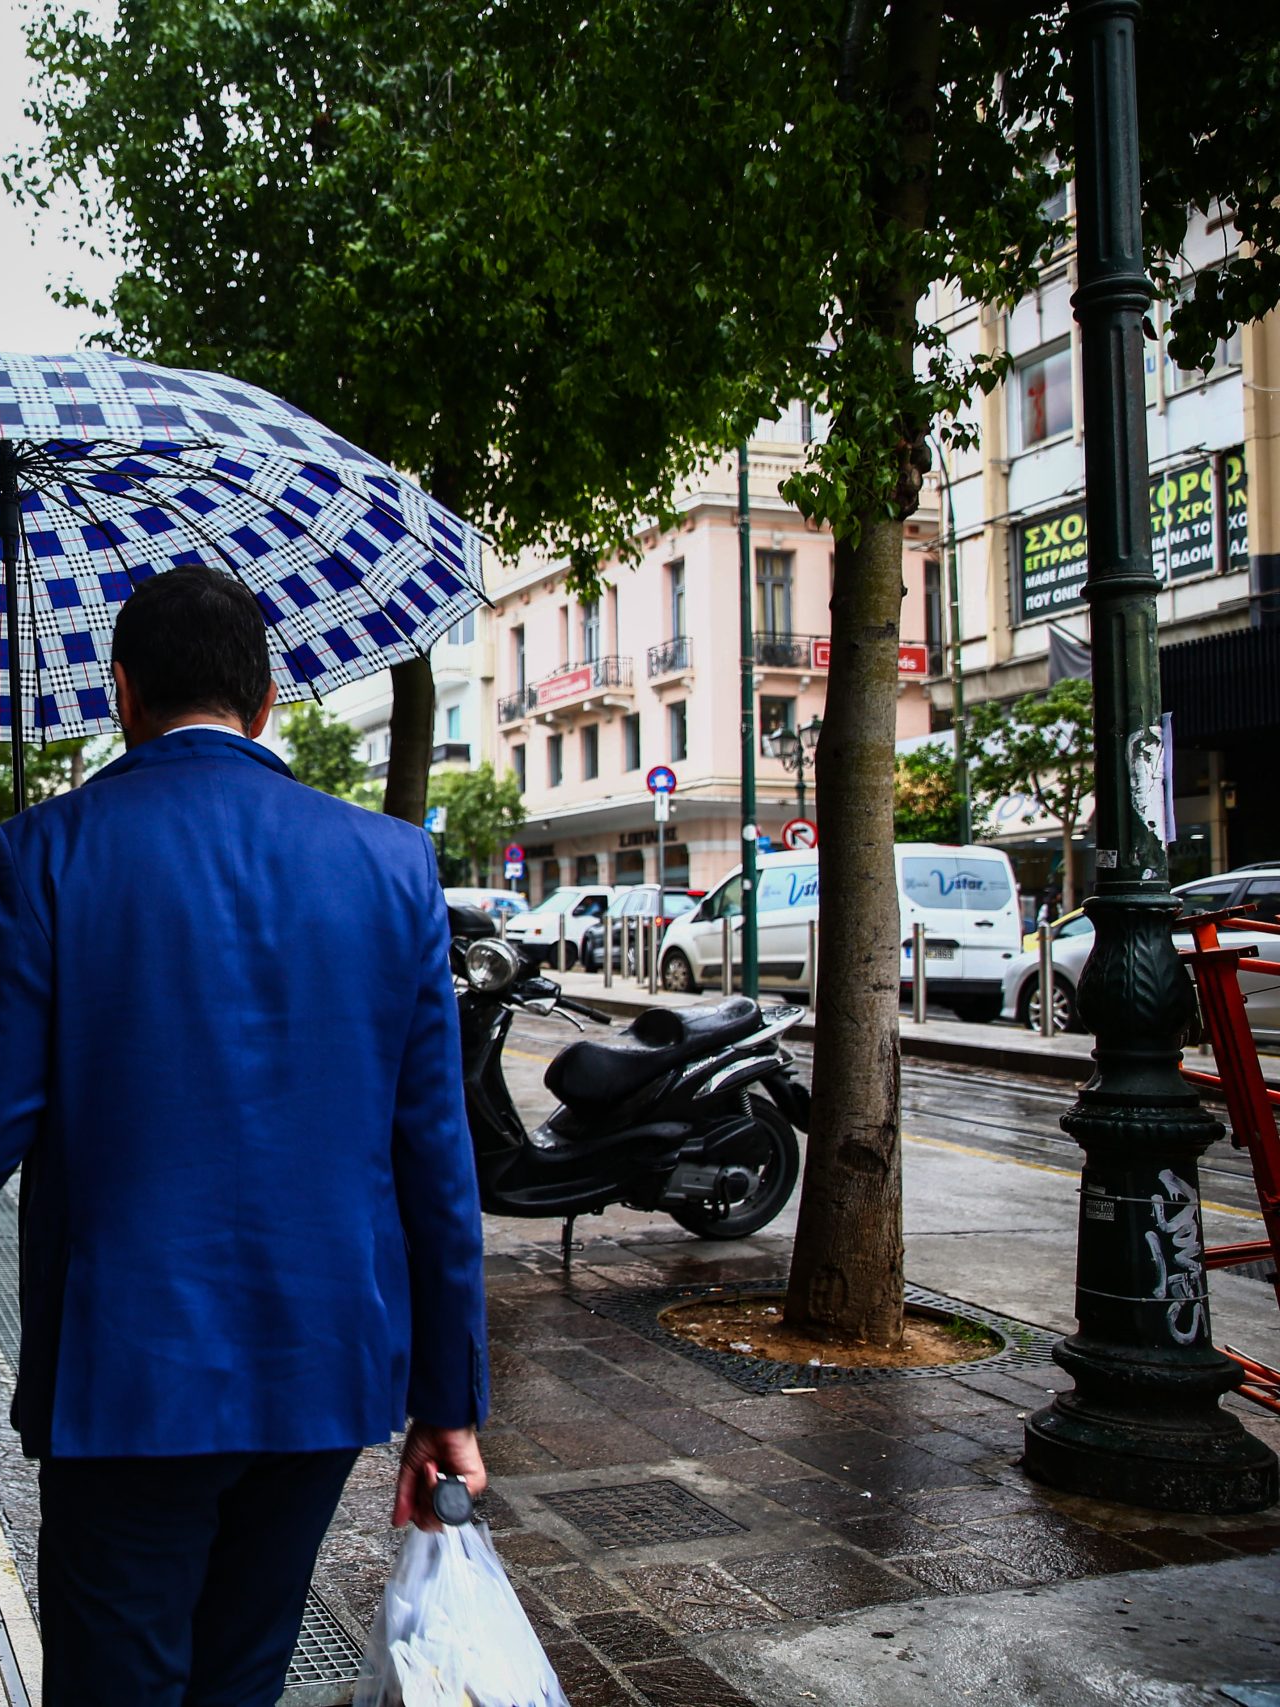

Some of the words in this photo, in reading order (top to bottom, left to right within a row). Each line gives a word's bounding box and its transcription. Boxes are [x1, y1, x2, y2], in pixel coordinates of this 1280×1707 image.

[1024, 513, 1088, 554] ΣΧΟ
[1024, 540, 1088, 573] ΕΓΓΡΑΦ
[1025, 568, 1058, 589] ΜΑΘΕ
[1025, 591, 1052, 611] ΠΟΥ
[787, 872, 819, 905] Vst
